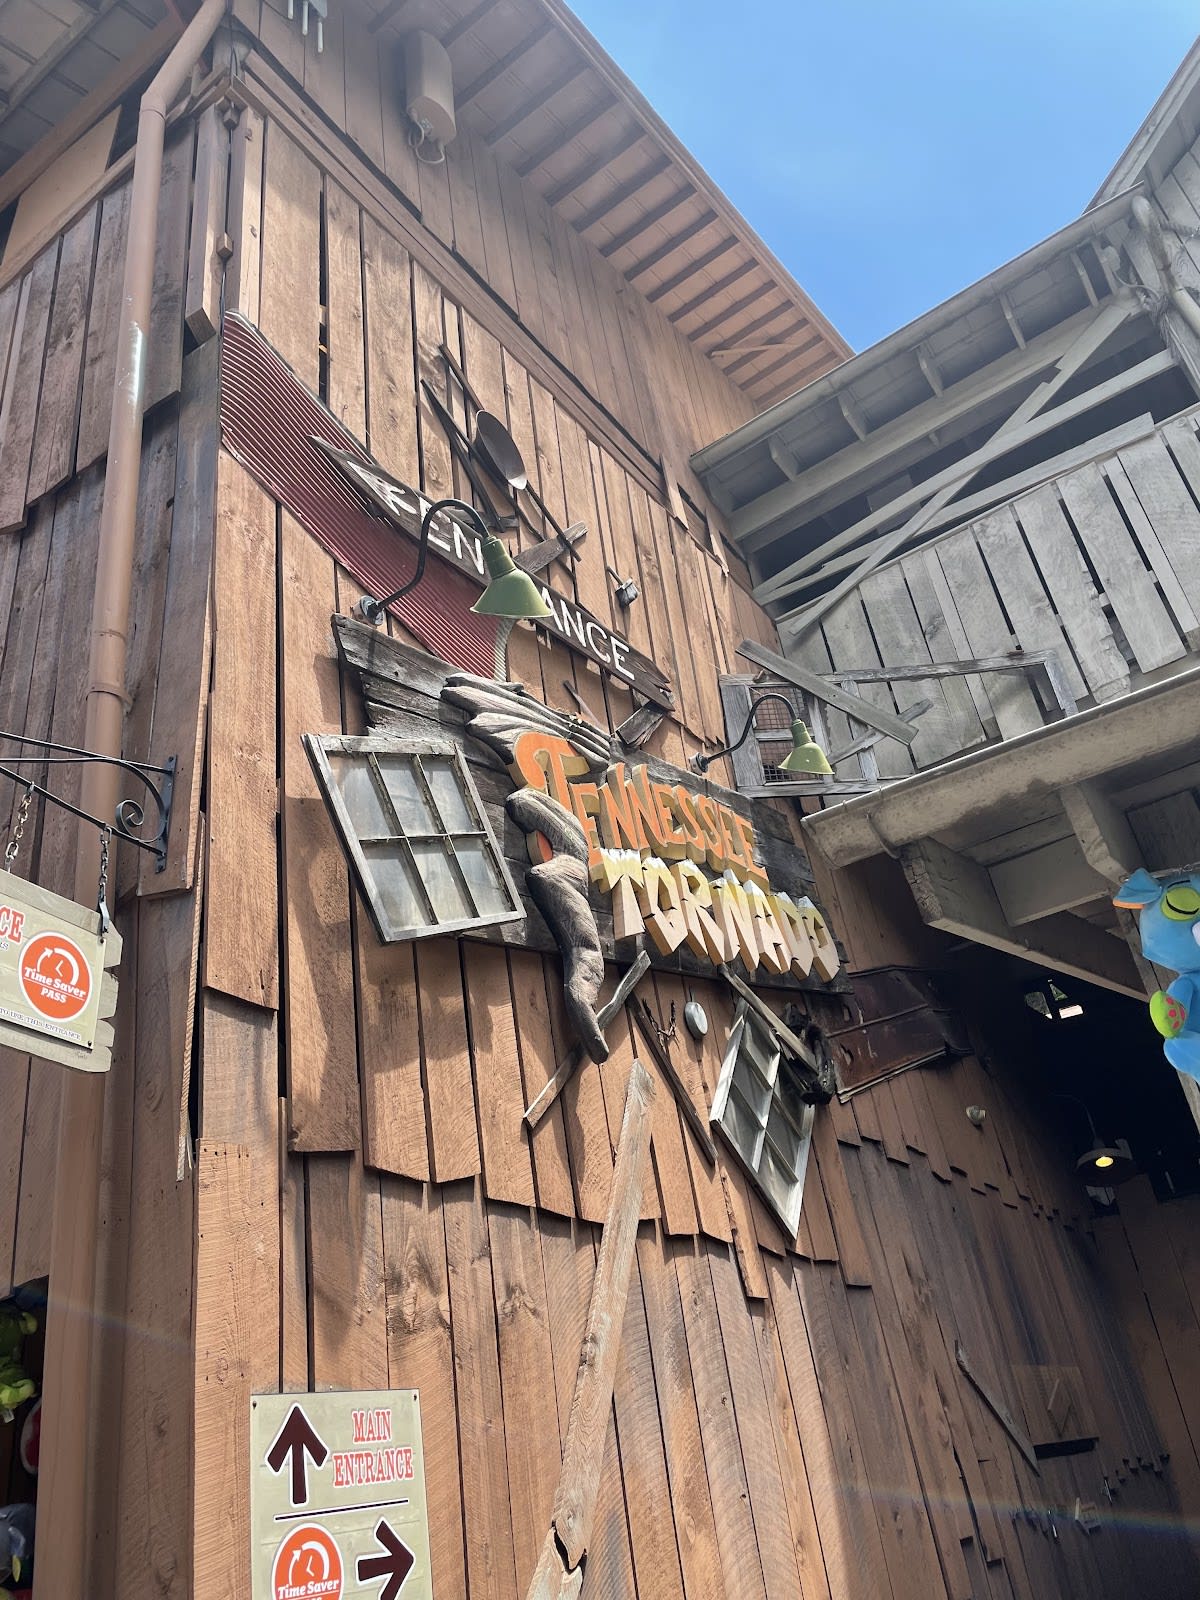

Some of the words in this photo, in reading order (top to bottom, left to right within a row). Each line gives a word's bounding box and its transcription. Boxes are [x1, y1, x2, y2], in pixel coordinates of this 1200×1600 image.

[418, 496, 635, 681] ENANCE
[513, 732, 768, 886] TENNESSEE
[599, 848, 840, 983] TORNADO
[25, 966, 53, 986] Time
[53, 978, 87, 998] Saver
[41, 987, 67, 1004] PASS
[352, 1410, 391, 1443] MAIN
[333, 1448, 414, 1487] ENTRANCE
[278, 1583, 306, 1600] Time
[307, 1579, 340, 1595] Saver
